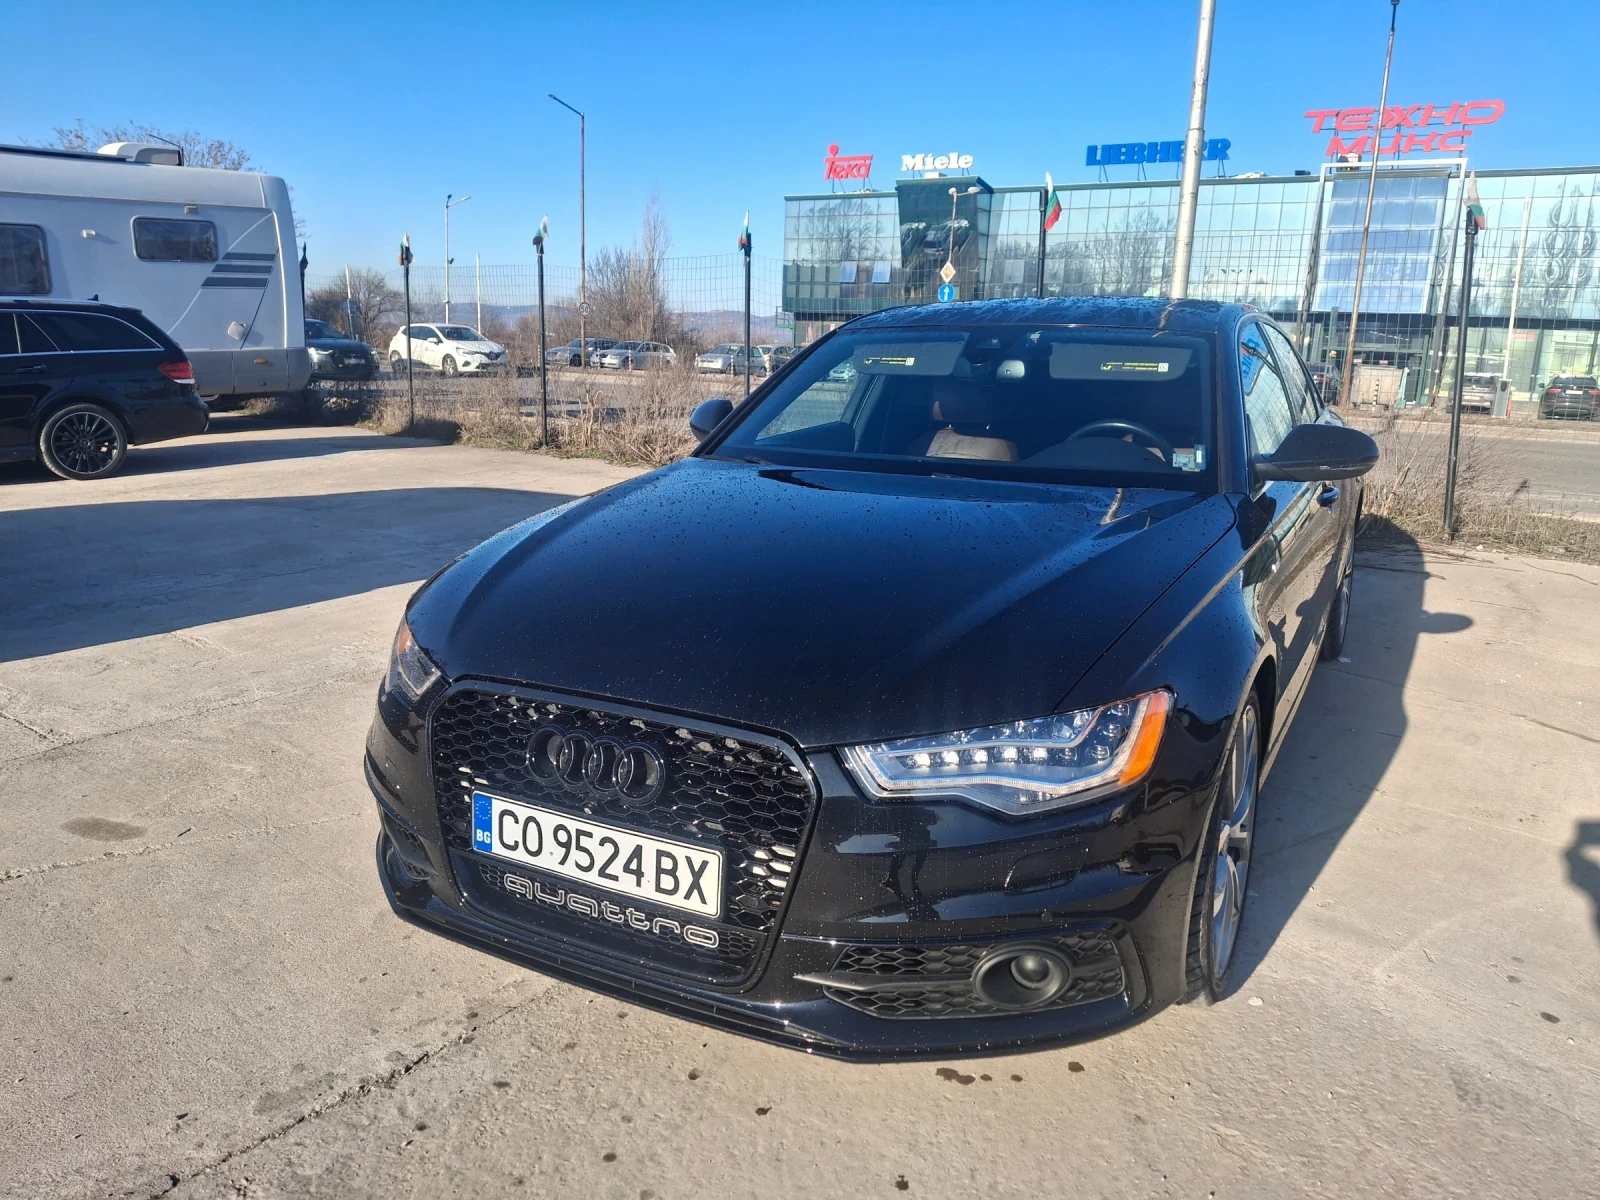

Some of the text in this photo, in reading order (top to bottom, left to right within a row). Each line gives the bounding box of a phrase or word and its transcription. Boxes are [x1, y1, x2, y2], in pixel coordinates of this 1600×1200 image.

[824, 144, 873, 180] Teka
[901, 152, 974, 172] Miele
[1086, 138, 1231, 166] LIEBHER
[581, 305, 588, 313] 50
[476, 830, 491, 844] BG
[552, 824, 645, 888] 9524
[655, 849, 709, 905] BX
[504, 874, 719, 948] quattro
